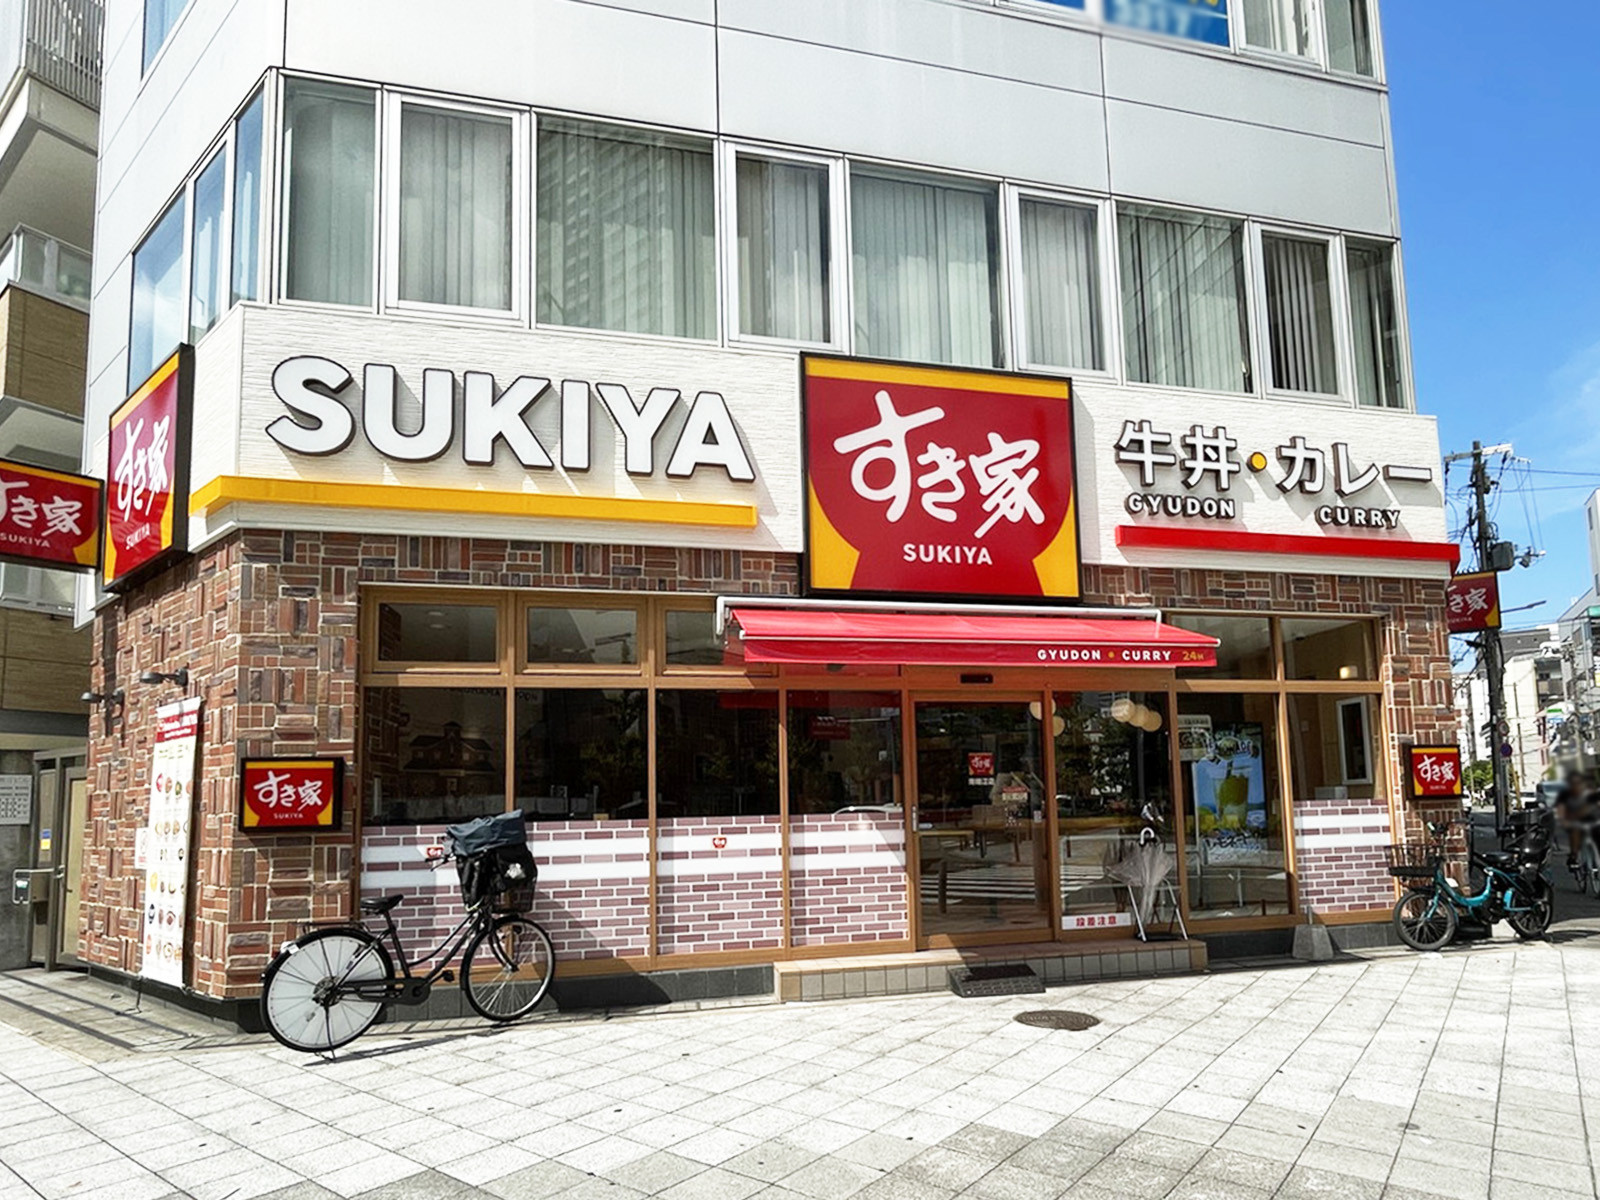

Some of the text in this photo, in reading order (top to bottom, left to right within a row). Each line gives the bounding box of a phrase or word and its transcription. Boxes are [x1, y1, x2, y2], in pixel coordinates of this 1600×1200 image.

[265, 355, 756, 482] SUKIYA
[115, 415, 169, 521] すき家
[833, 390, 1045, 539] すき家
[1125, 492, 1400, 529] GYUDON CURRY
[903, 543, 993, 565] SUKIYA
[1447, 585, 1488, 615] き家
[1037, 649, 1101, 661] GYUDON
[1122, 650, 1171, 661] CURRY
[1417, 754, 1455, 784] すき家
[253, 770, 322, 811] すき家
